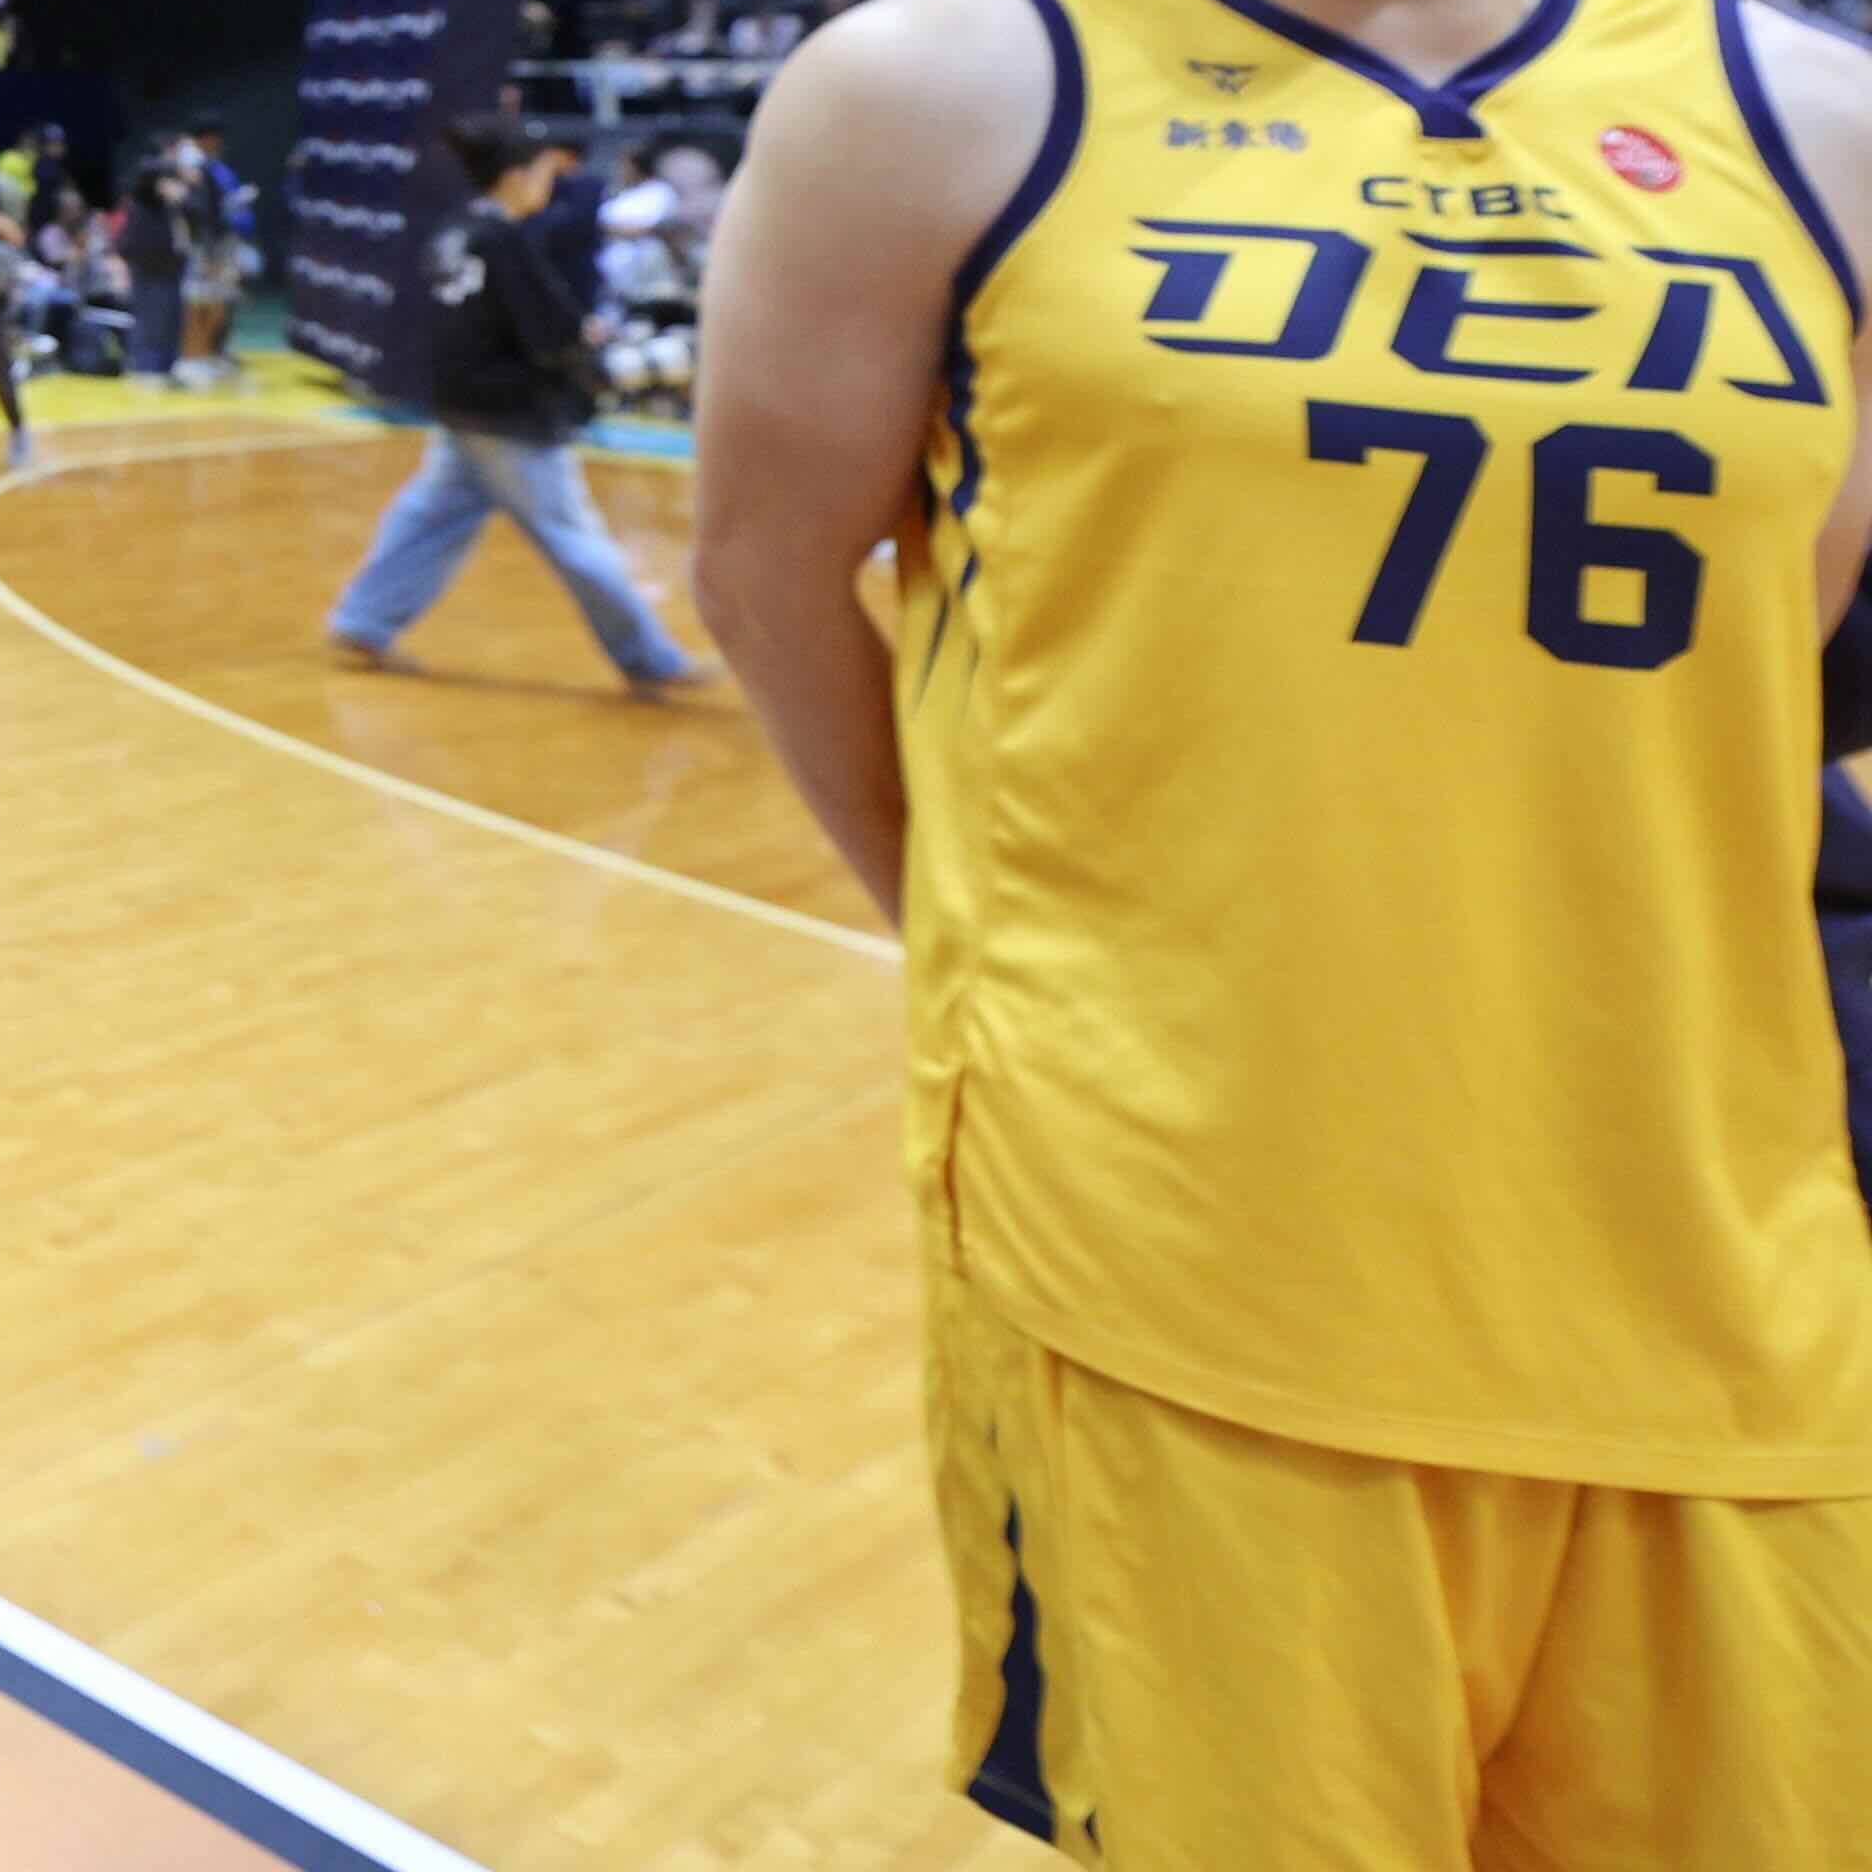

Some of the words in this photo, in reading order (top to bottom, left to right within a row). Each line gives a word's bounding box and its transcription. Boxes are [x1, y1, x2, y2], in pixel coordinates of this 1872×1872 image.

[1360, 175, 1573, 219] CTBC
[1130, 217, 1831, 408] DEA
[1305, 399, 1718, 673] 76
